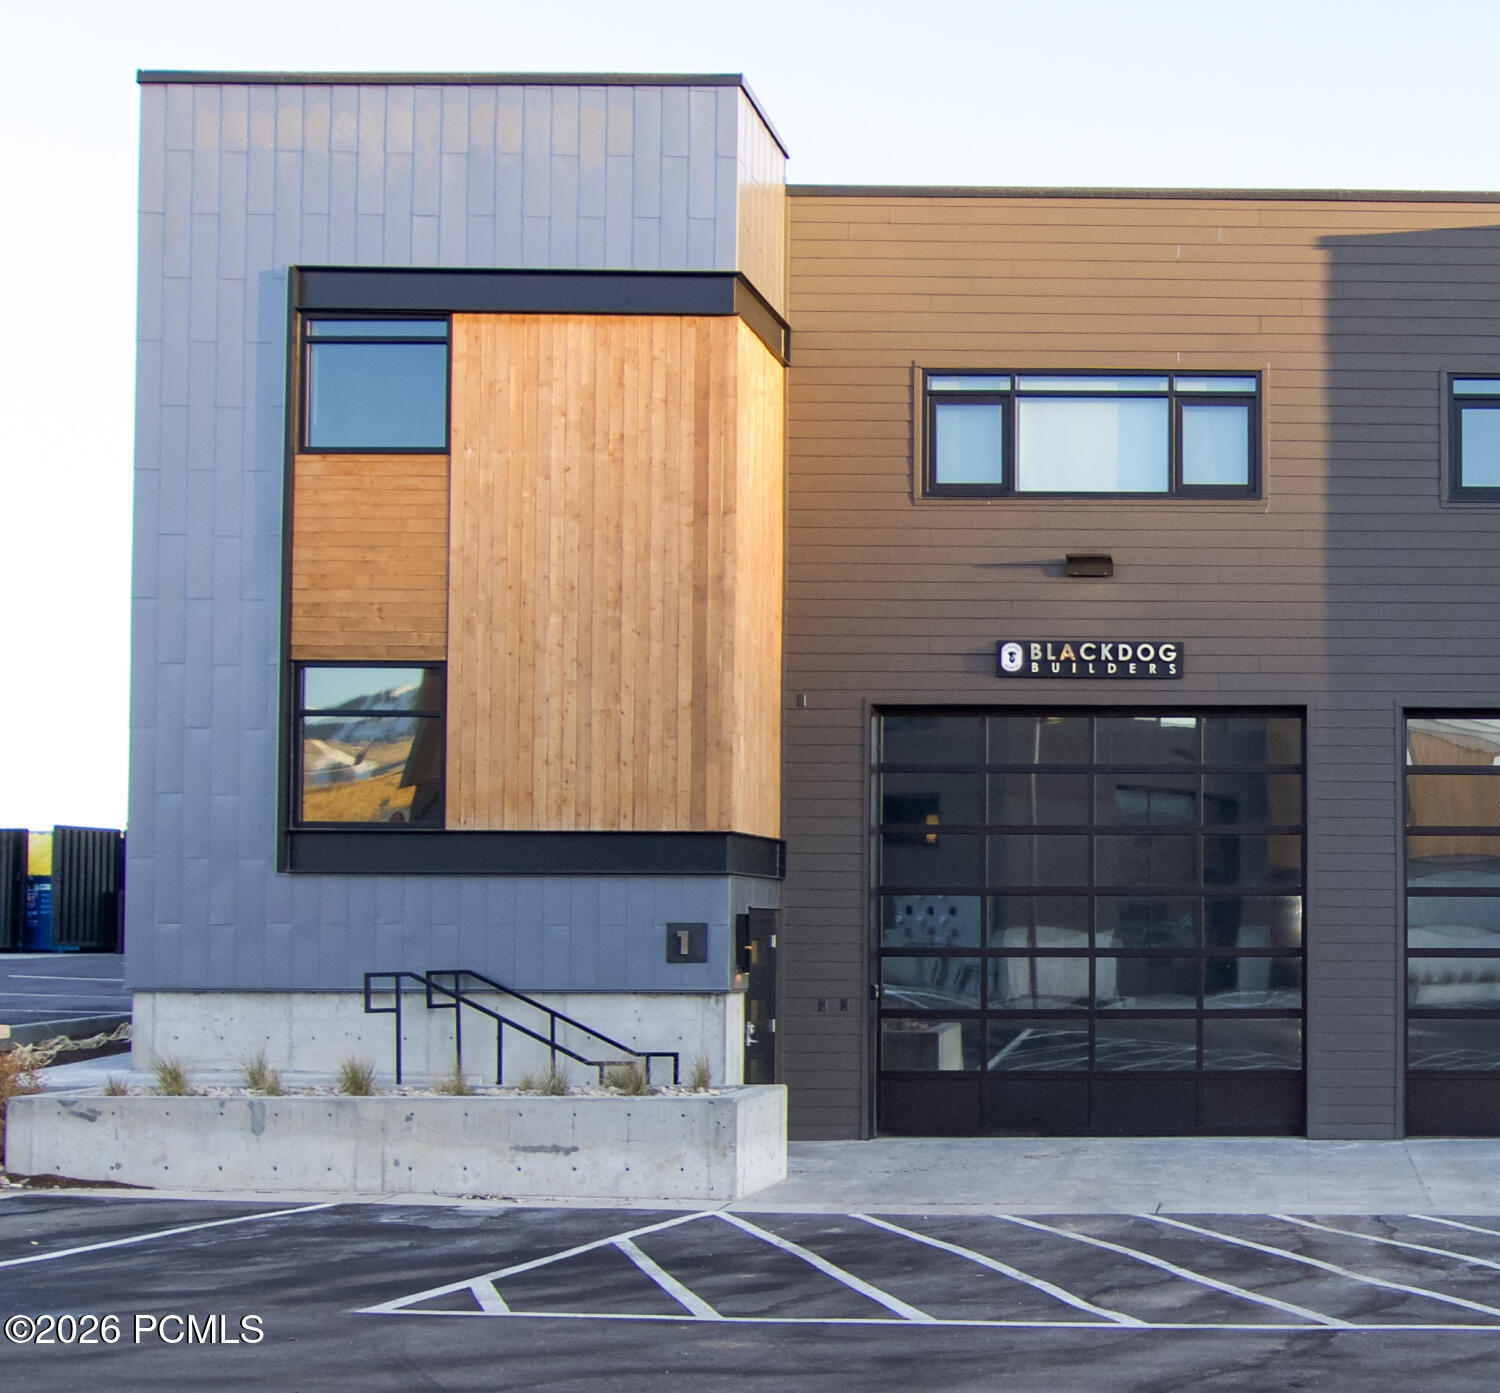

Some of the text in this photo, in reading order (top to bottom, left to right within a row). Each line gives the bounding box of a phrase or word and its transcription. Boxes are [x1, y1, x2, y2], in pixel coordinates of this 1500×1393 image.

[1030, 643, 1177, 662] BLACKDOG
[1031, 662, 1177, 675] BUILDERS
[677, 930, 689, 955] 1
